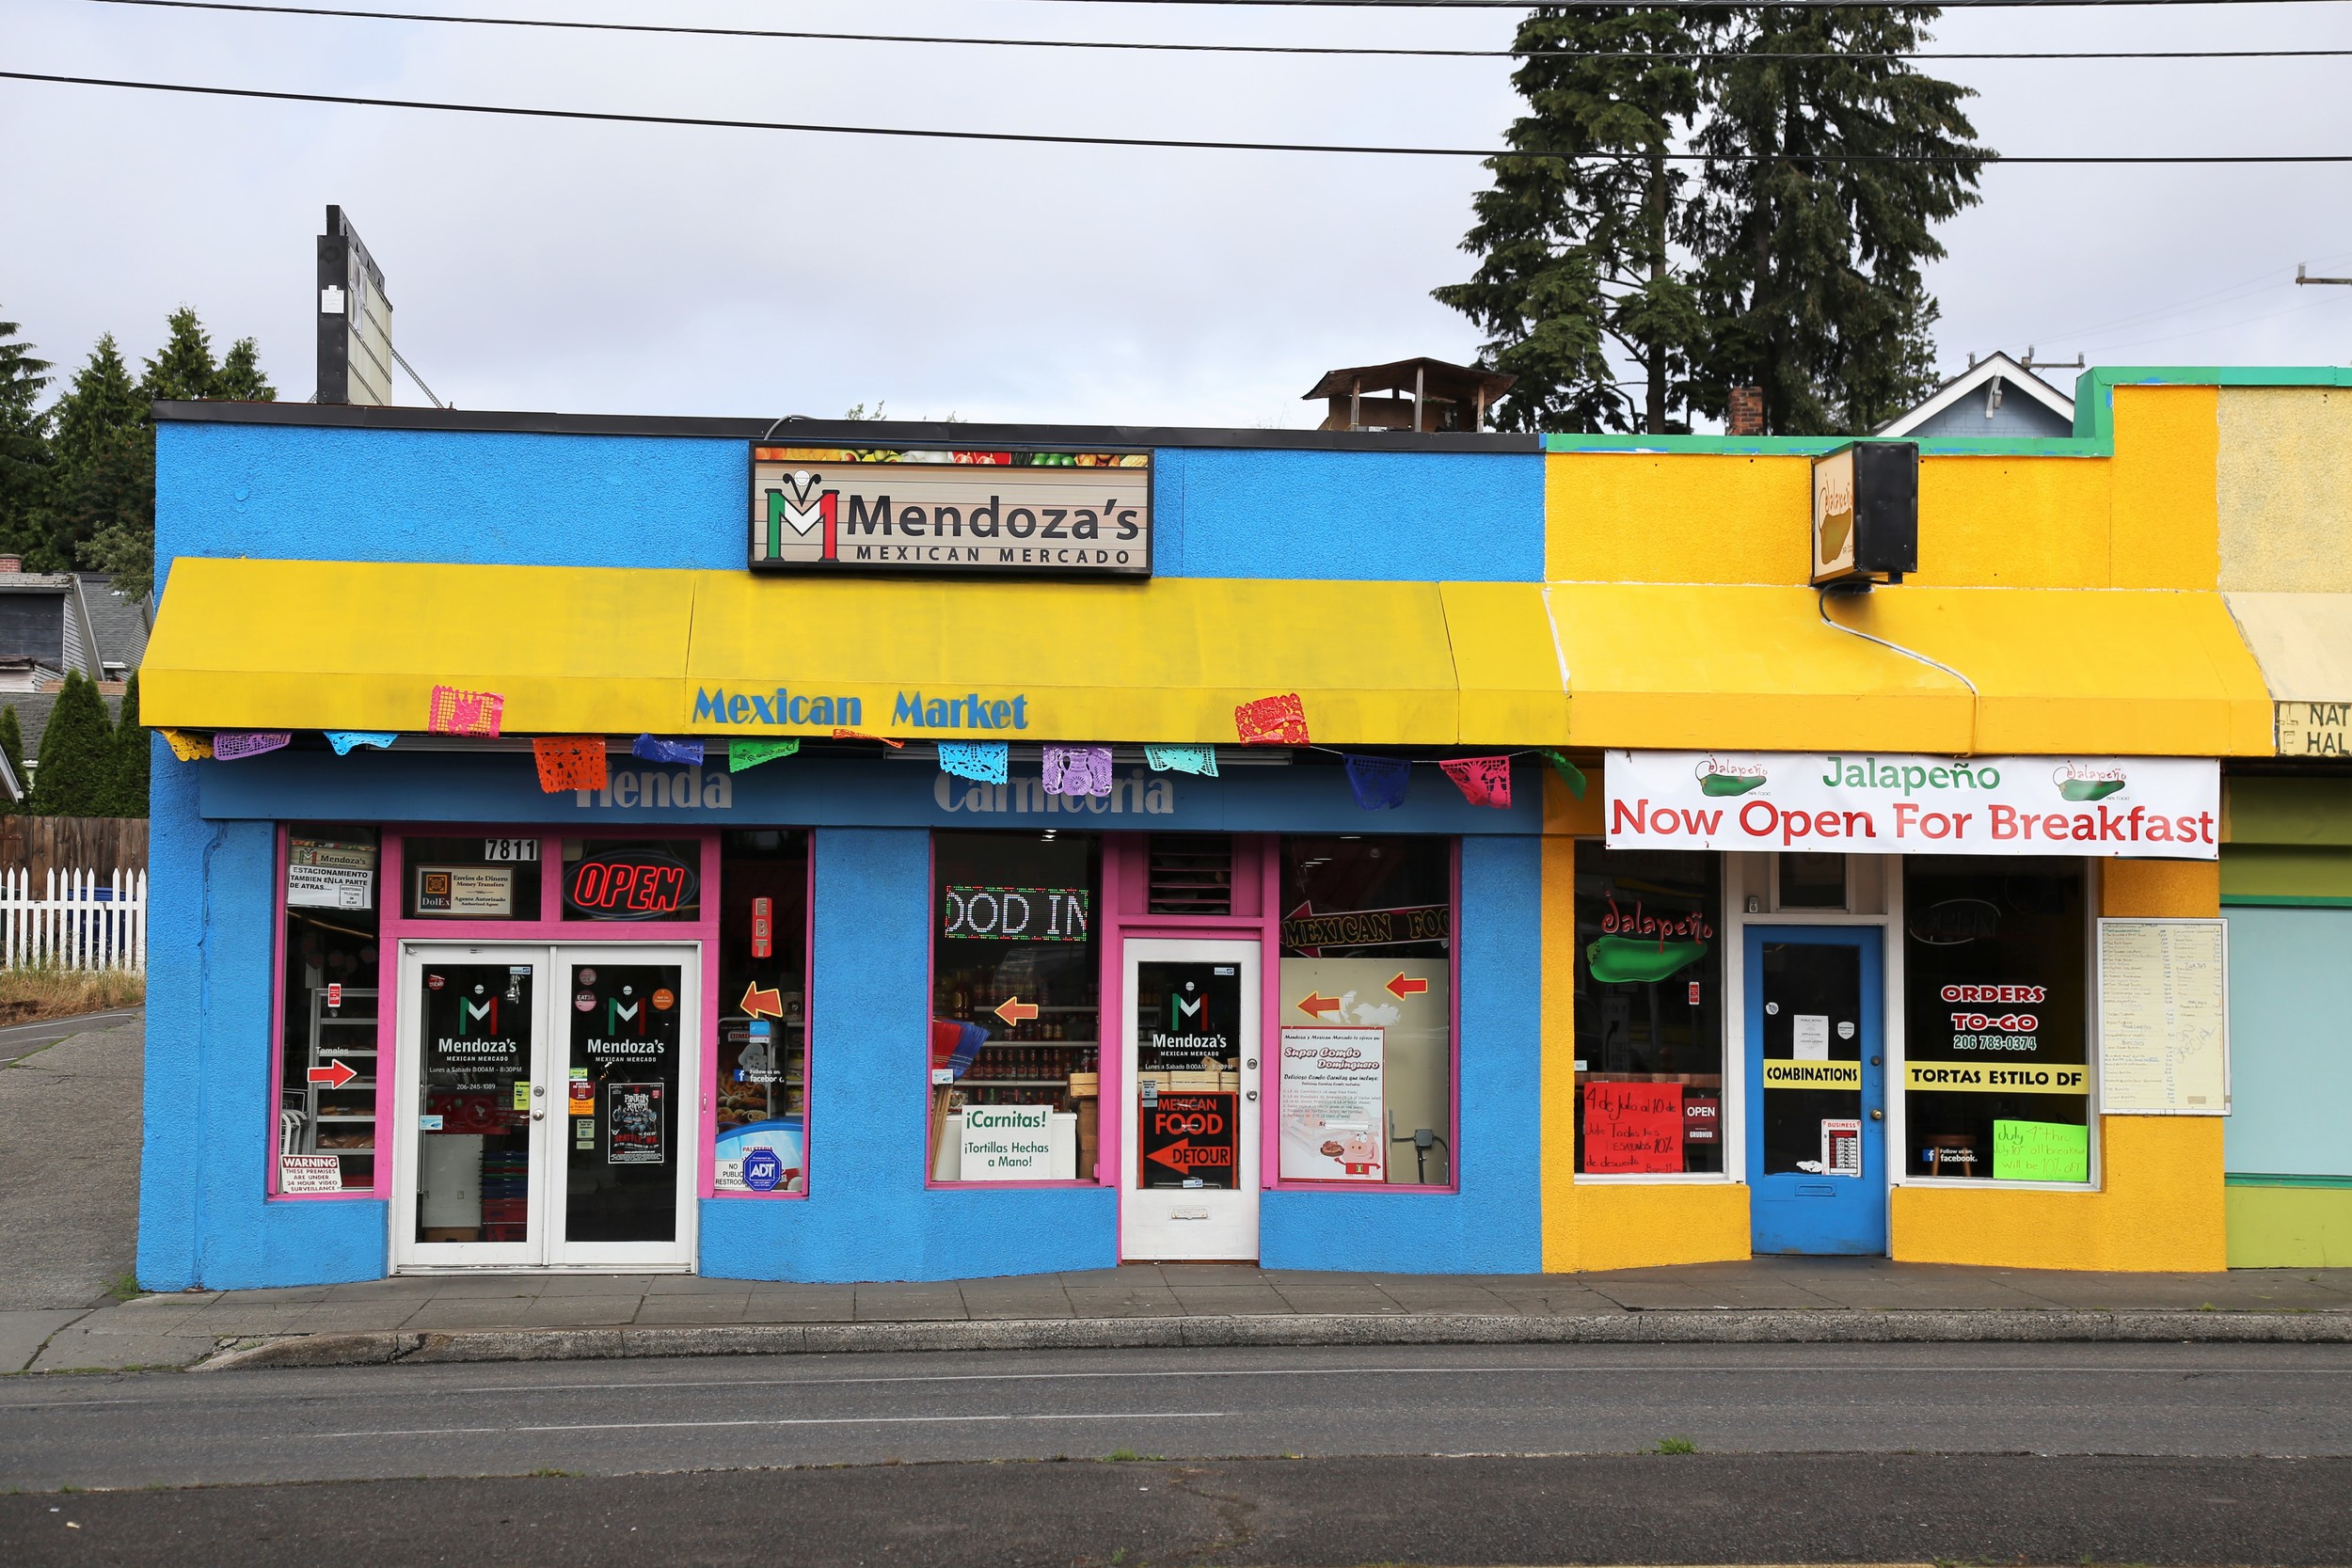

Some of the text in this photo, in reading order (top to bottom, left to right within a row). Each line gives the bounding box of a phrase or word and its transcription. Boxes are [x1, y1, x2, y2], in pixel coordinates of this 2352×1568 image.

[847, 495, 1139, 541] Mendoza's
[856, 546, 1131, 565] MEXICAN MERCADO
[692, 687, 1028, 730] Mexican Market
[1823, 756, 2001, 797] Jalapeño
[1611, 799, 2214, 846] Now Open For Breakfast
[487, 839, 535, 860] 7811
[320, 854, 367, 865] Mendoza's
[291, 875, 322, 883] TAMBIEN
[293, 867, 368, 879] ESTACIONAMIENTO
[574, 863, 684, 911] OPEN
[421, 896, 451, 907] DolEx
[755, 897, 768, 958] EBT
[1283, 913, 1392, 948] MEXICAN
[1601, 893, 1713, 955] Jalapeño
[1941, 985, 2047, 1004] ORDERS
[1951, 1012, 2039, 1032] TO-GO
[438, 1037, 516, 1053] Mendoza's
[587, 1038, 665, 1053] Mendoza's
[1152, 1033, 1227, 1048] Mendoza's
[1953, 1035, 2037, 1051] 206 783-0374
[1284, 1047, 1361, 1059] Super Combo
[1317, 1059, 1380, 1071] Dominguero
[1767, 1067, 1858, 1082] COMBINATIONS
[1912, 1069, 2082, 1086] TORTAS ESTILO DF
[1157, 1098, 1216, 1111] MEXICAN
[1598, 1089, 1613, 1113] de
[1640, 1099, 1650, 1113] al
[1652, 1098, 1664, 1115] 10
[1665, 1101, 1676, 1112] de
[966, 1110, 1046, 1129] ¡Carnitas!
[1687, 1106, 1715, 1117] OPEN
[1155, 1113, 1223, 1135] FOOD
[1607, 1122, 1640, 1138] Todos
[1997, 1124, 2024, 1146] July
[964, 1141, 1049, 1155] ¡Tortillas Hechas
[1653, 1135, 1674, 1154] 10%
[283, 1157, 337, 1167] WARNING
[988, 1156, 1032, 1167] a Mano!
[1172, 1148, 1229, 1164] DETOUR
[1586, 1154, 1640, 1167] de descuento
[750, 1163, 775, 1178] ADT
[2001, 1160, 2021, 1169] will
[2026, 1160, 2039, 1170] be
